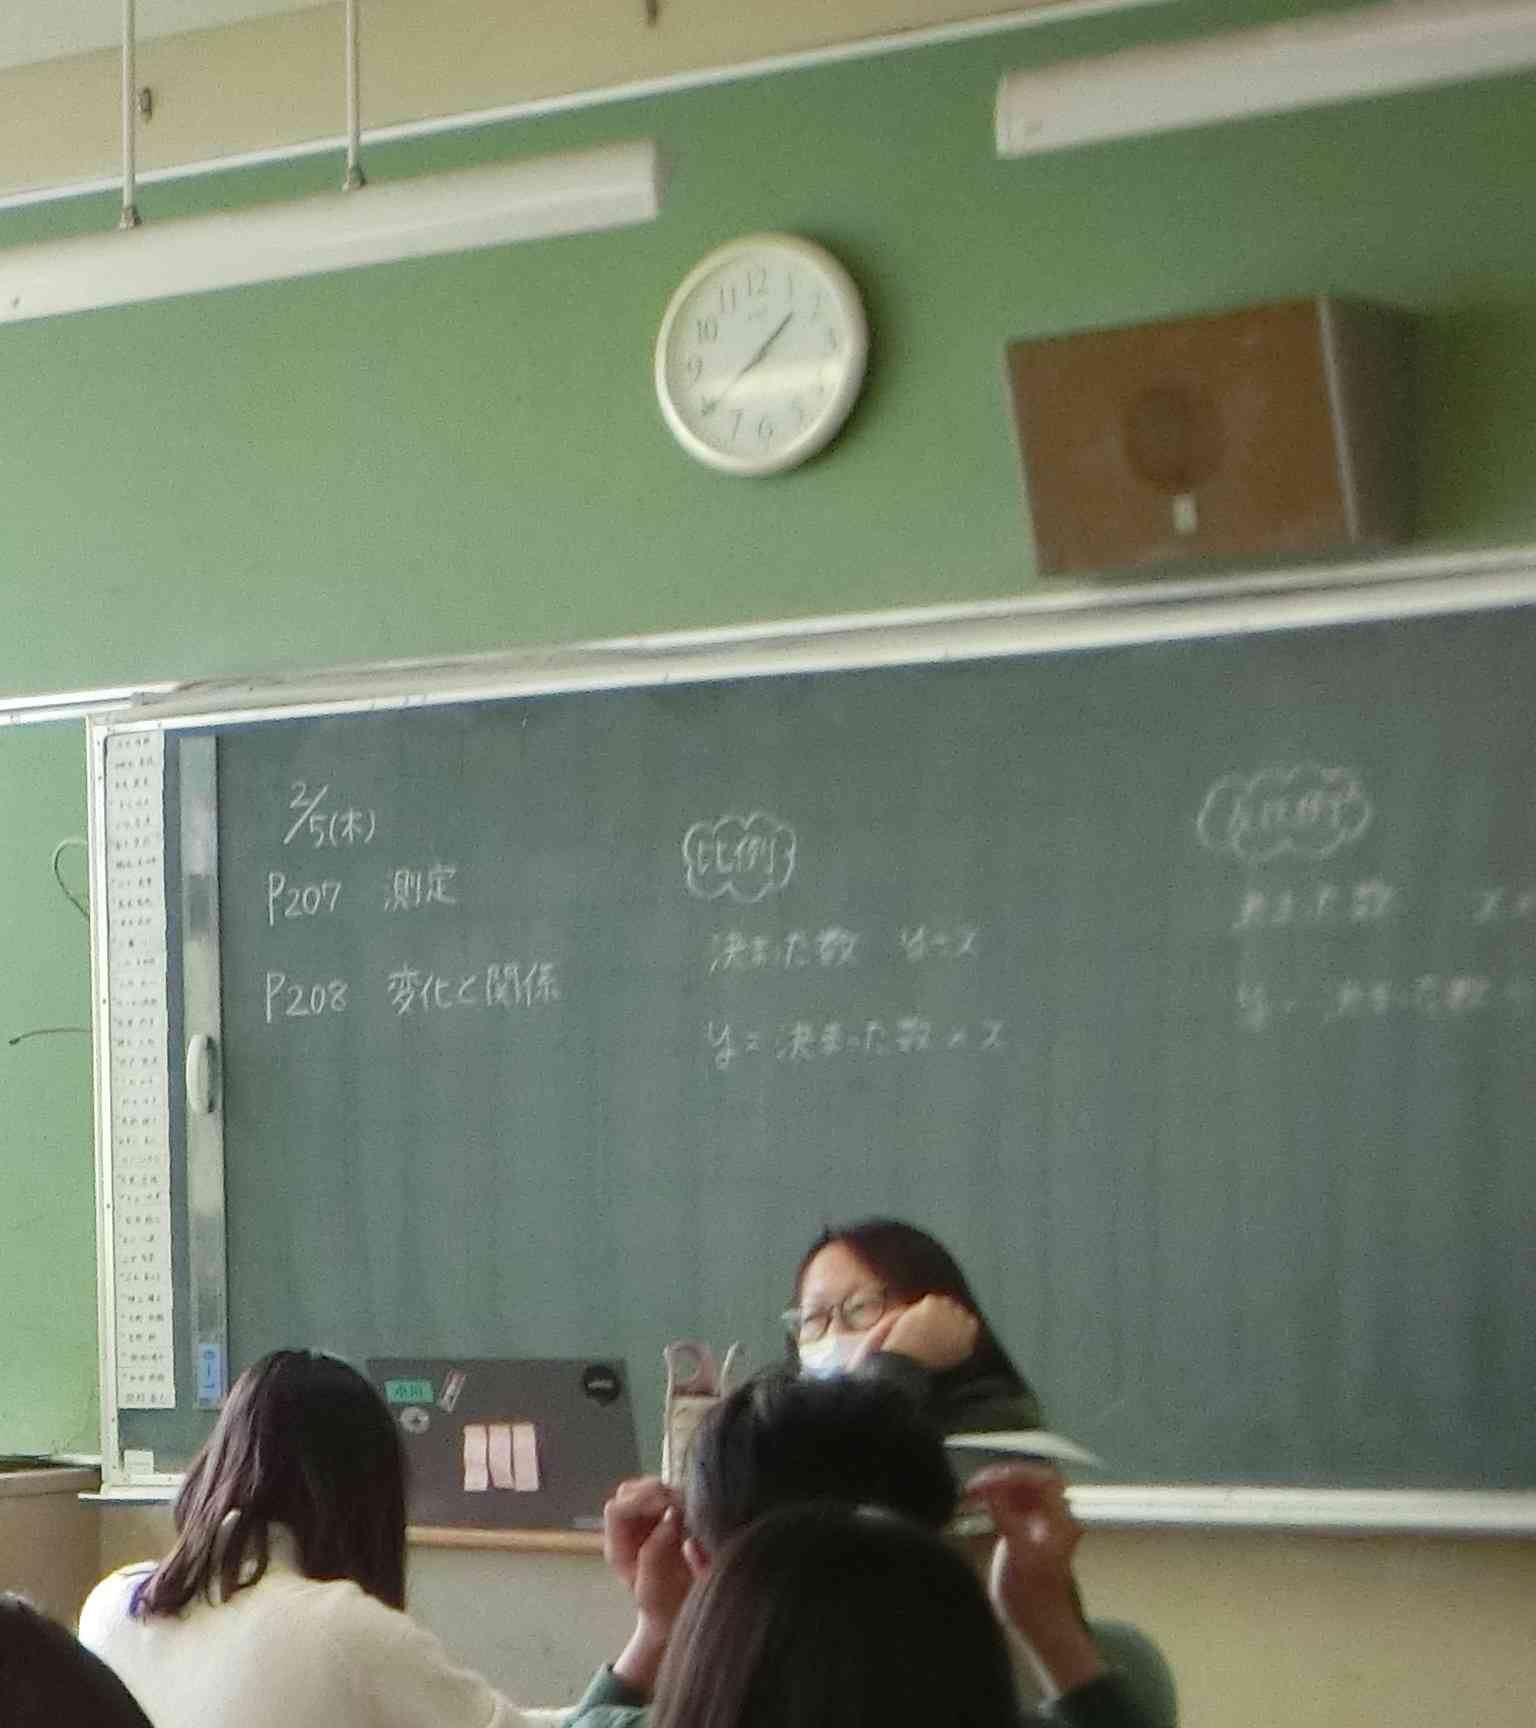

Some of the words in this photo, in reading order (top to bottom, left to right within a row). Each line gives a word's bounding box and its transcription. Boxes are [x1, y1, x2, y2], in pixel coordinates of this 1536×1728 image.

[267, 871, 343, 928] P207
[383, 864, 458, 912] 測定
[265, 971, 349, 1025] P208
